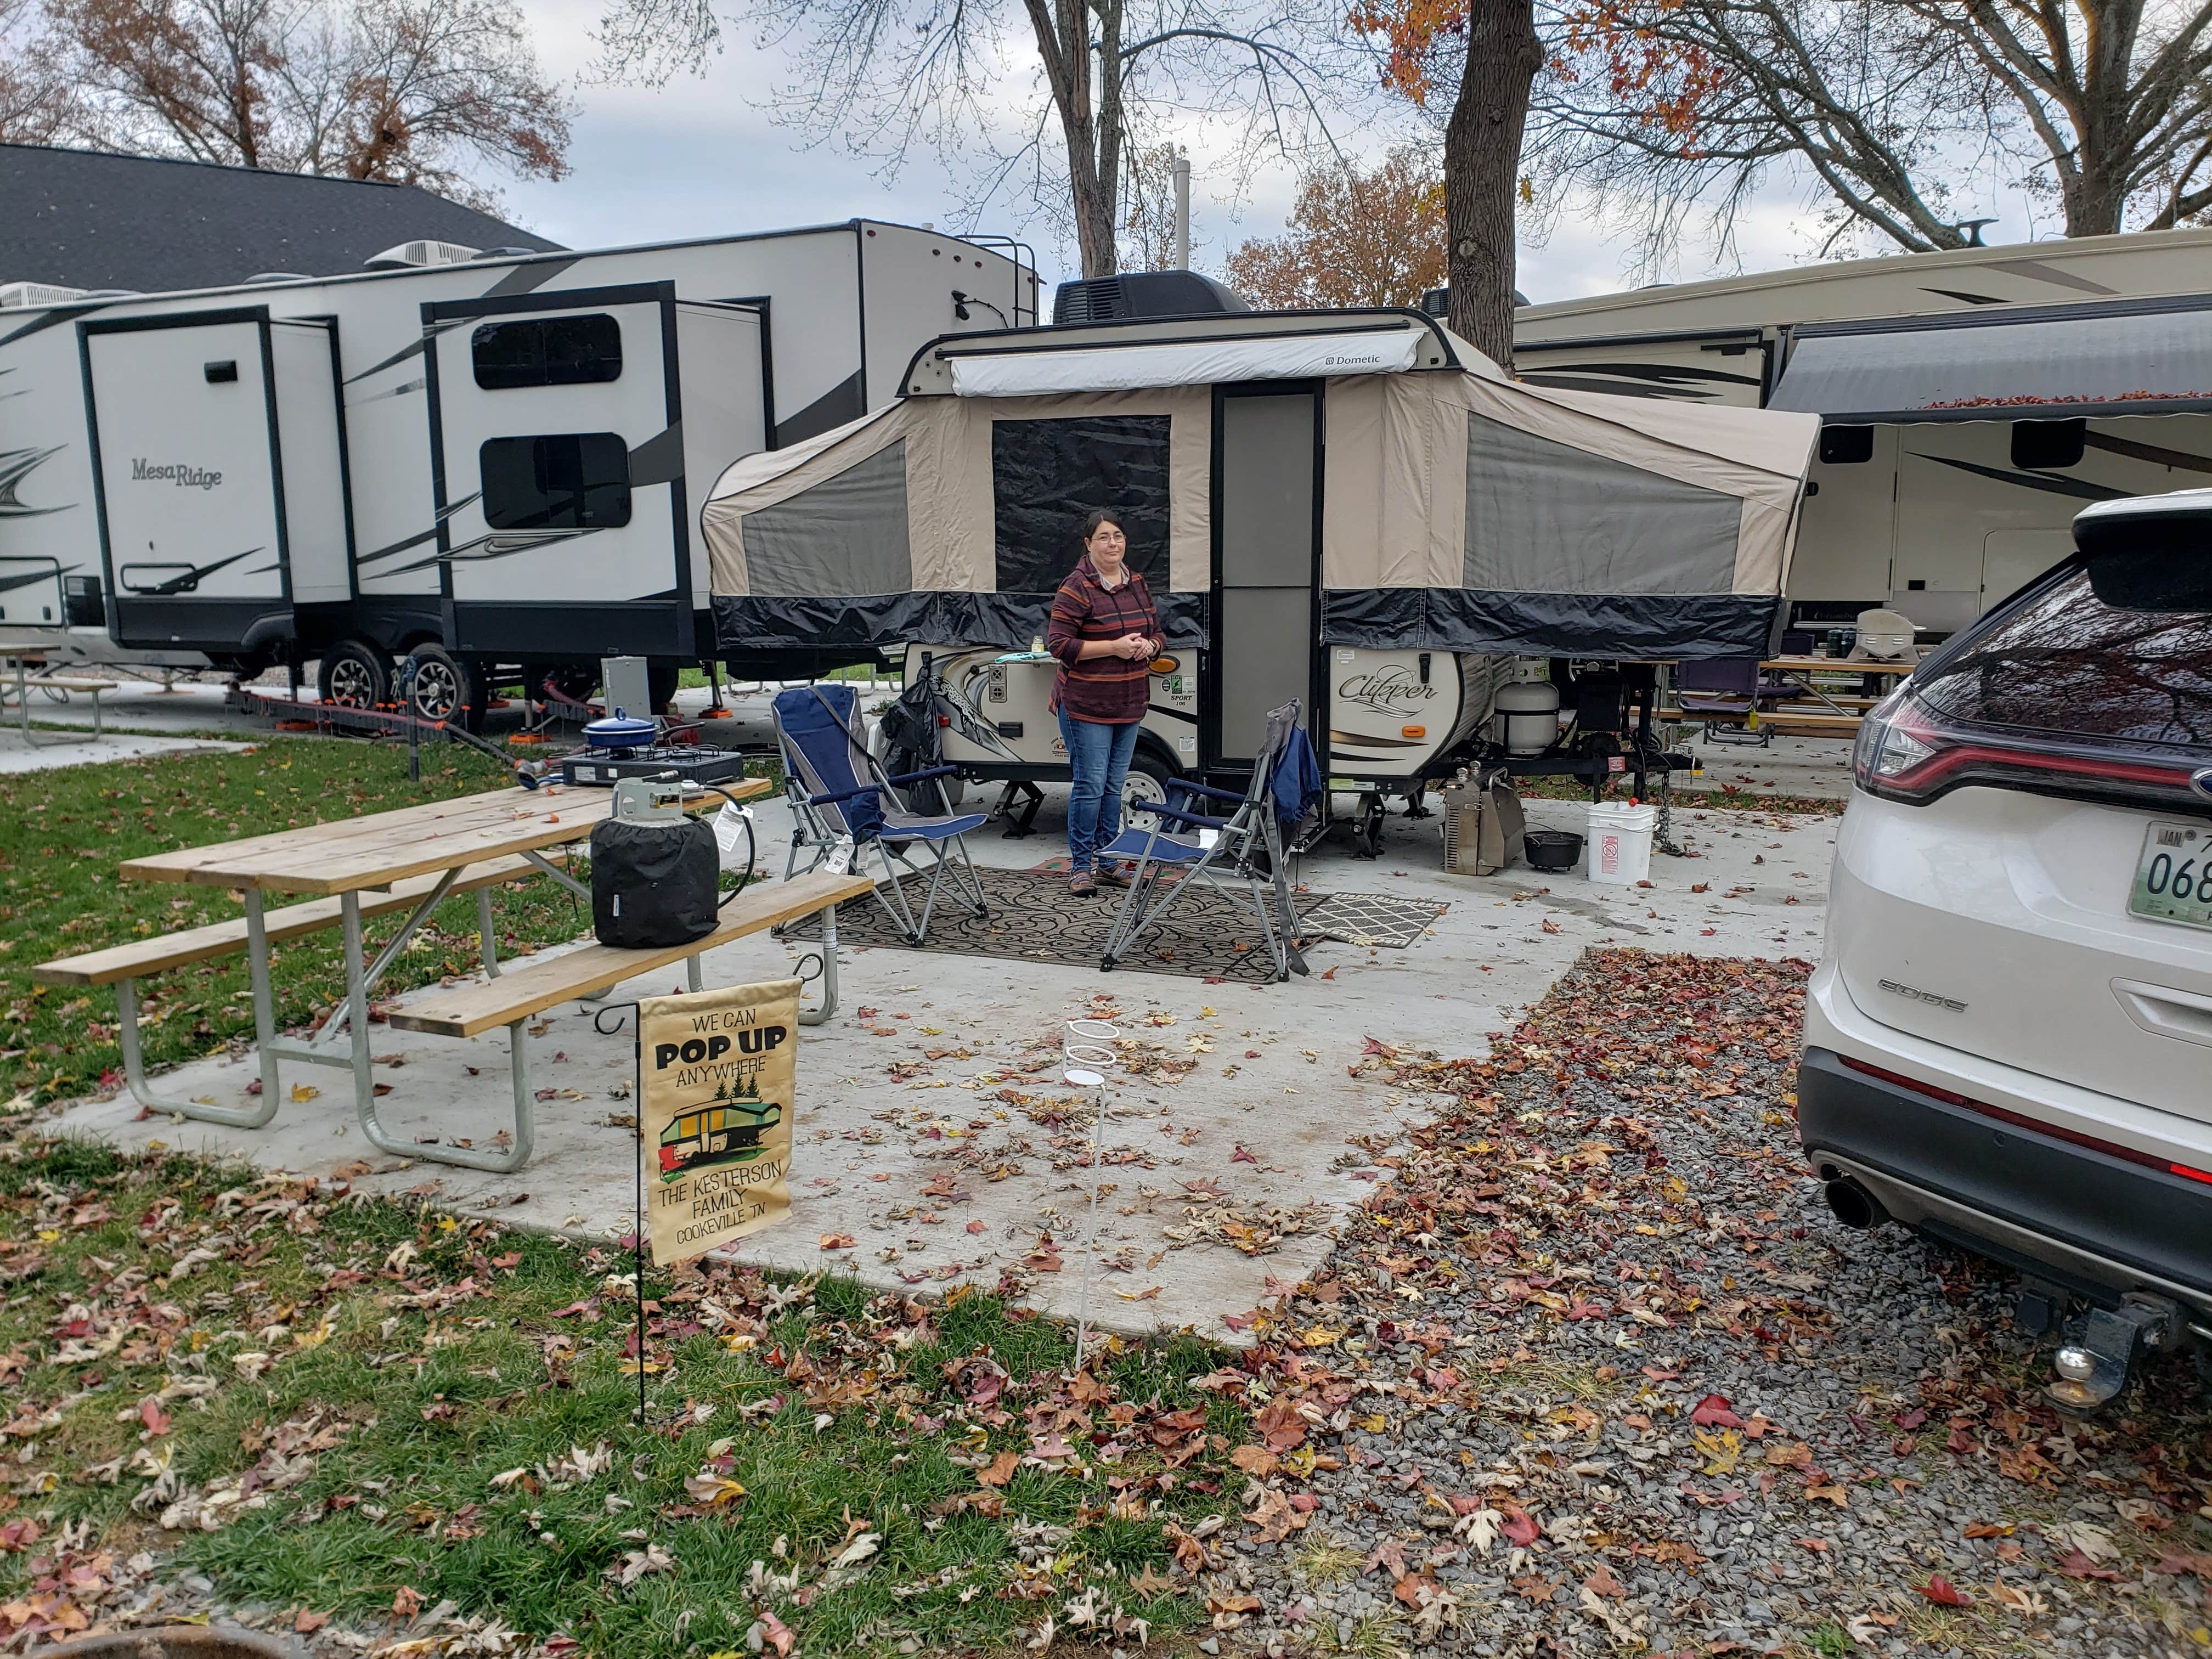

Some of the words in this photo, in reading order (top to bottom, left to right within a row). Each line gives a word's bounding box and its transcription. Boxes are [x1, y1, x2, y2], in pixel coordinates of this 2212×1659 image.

[1337, 355, 1380, 364] Dometic
[1339, 665, 1438, 704] Clipper
[2163, 830, 2182, 848] JAN
[1877, 978, 1968, 1012] EDGE
[692, 1013, 718, 1033] WE
[724, 1009, 756, 1028] CAN
[655, 1035, 731, 1070] POP
[738, 1025, 787, 1054] UP
[675, 1056, 766, 1087] ANYWHERE
[658, 1183, 687, 1207] THE
[693, 1159, 781, 1197] KESTERSON
[693, 1189, 748, 1219] FAMILY
[677, 1209, 746, 1244] COOKEVILLE
[749, 1202, 766, 1218] TN
